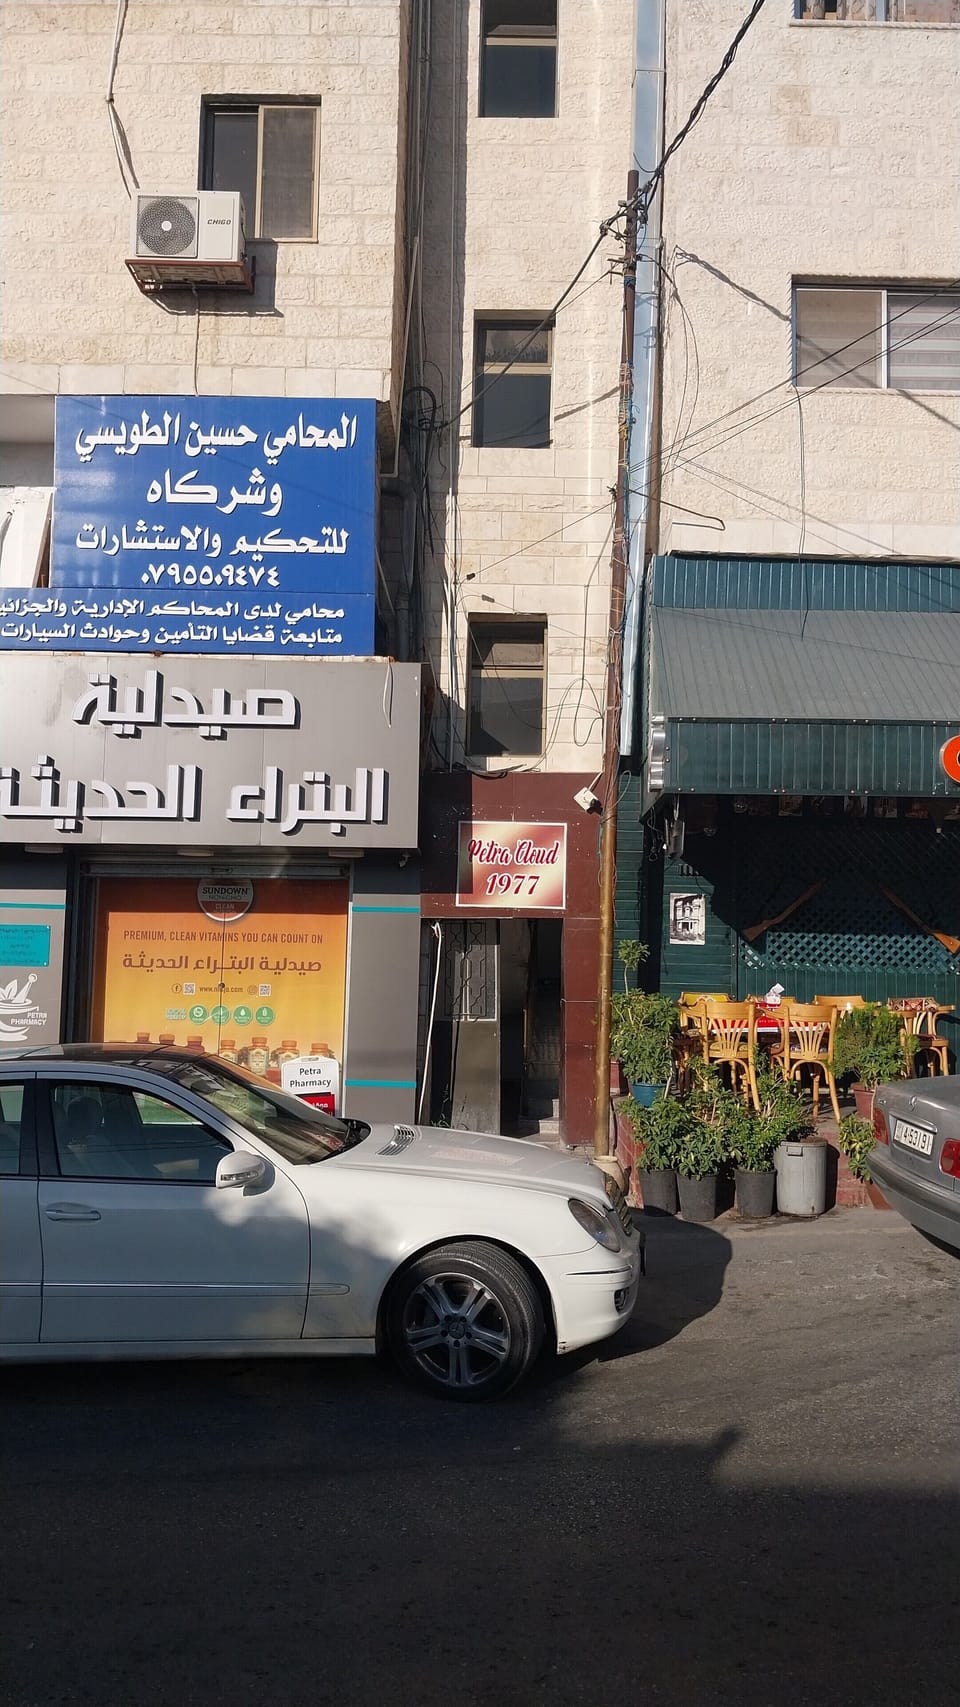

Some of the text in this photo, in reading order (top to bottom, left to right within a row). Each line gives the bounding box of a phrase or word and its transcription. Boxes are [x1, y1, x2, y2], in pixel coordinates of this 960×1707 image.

[74, 410, 357, 465] المحامي حسين الطويسي
[146, 467, 283, 516] وشركاه
[75, 519, 349, 561] للتحكيم والاستشارات
[141, 562, 280, 587] ٠٧٩٥٥٠٩٤٧٤
[0, 598, 67, 617] والجزائي
[146, 600, 239, 618] المحاكم
[243, 602, 282, 620] لدى
[284, 603, 345, 625] محامي
[1, 622, 342, 648] متابعة قضايا التأمين وحوادث السيارات
[73, 670, 298, 738] صيدلية
[226, 765, 386, 834] البتراء
[468, 838, 512, 865] Petra
[202, 886, 249, 895] SUNDOWN
[486, 873, 540, 895] 1977
[123, 930, 323, 944] PREMIUM, CLEAN VITAMINS YOU CAN COUNT ON
[122, 951, 189, 973] الحديثة
[259, 956, 322, 976] صيدلية
[10, 1018, 47, 1026] PHARMACY
[299, 1068, 322, 1076] Petra
[289, 1079, 332, 1088] Pharmacy
